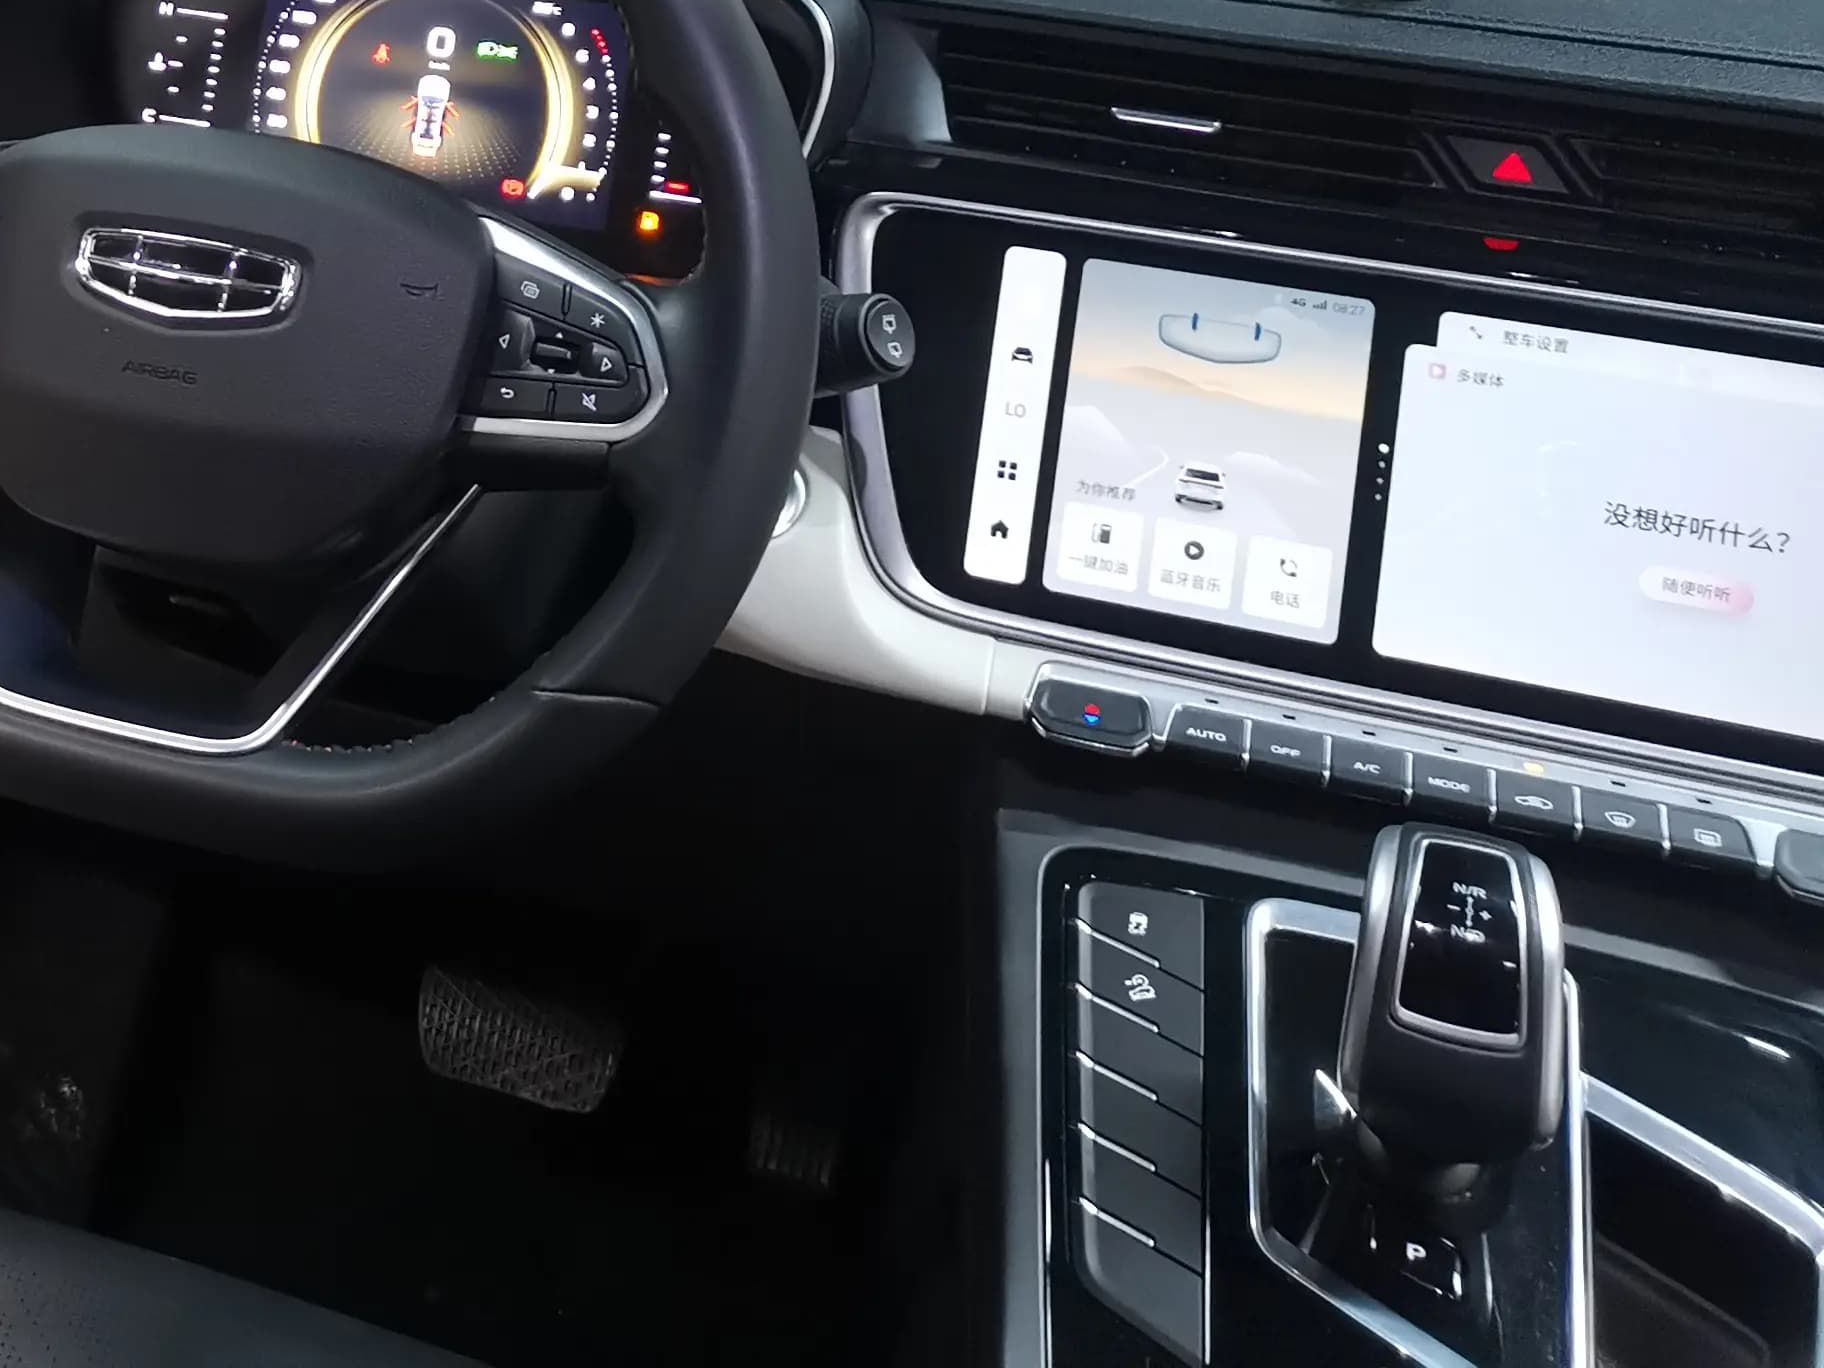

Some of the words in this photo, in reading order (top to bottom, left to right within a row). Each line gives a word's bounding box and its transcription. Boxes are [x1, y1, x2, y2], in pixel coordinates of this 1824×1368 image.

[426, 26, 457, 59] 0
[1503, 330, 1569, 353] 整车设置
[1456, 368, 1505, 387] 多媒体
[1075, 479, 1136, 502] 为你推荐
[1603, 501, 1791, 554] 没想好听什么?
[1160, 568, 1222, 592] 蓝牙音乐
[1661, 575, 1731, 603] 随便听听
[1270, 590, 1301, 609] 电话
[1185, 726, 1227, 742] AUTO
[1353, 761, 1382, 774] A/C
[1427, 775, 1472, 793] MODE
[1405, 1241, 1427, 1261] P
